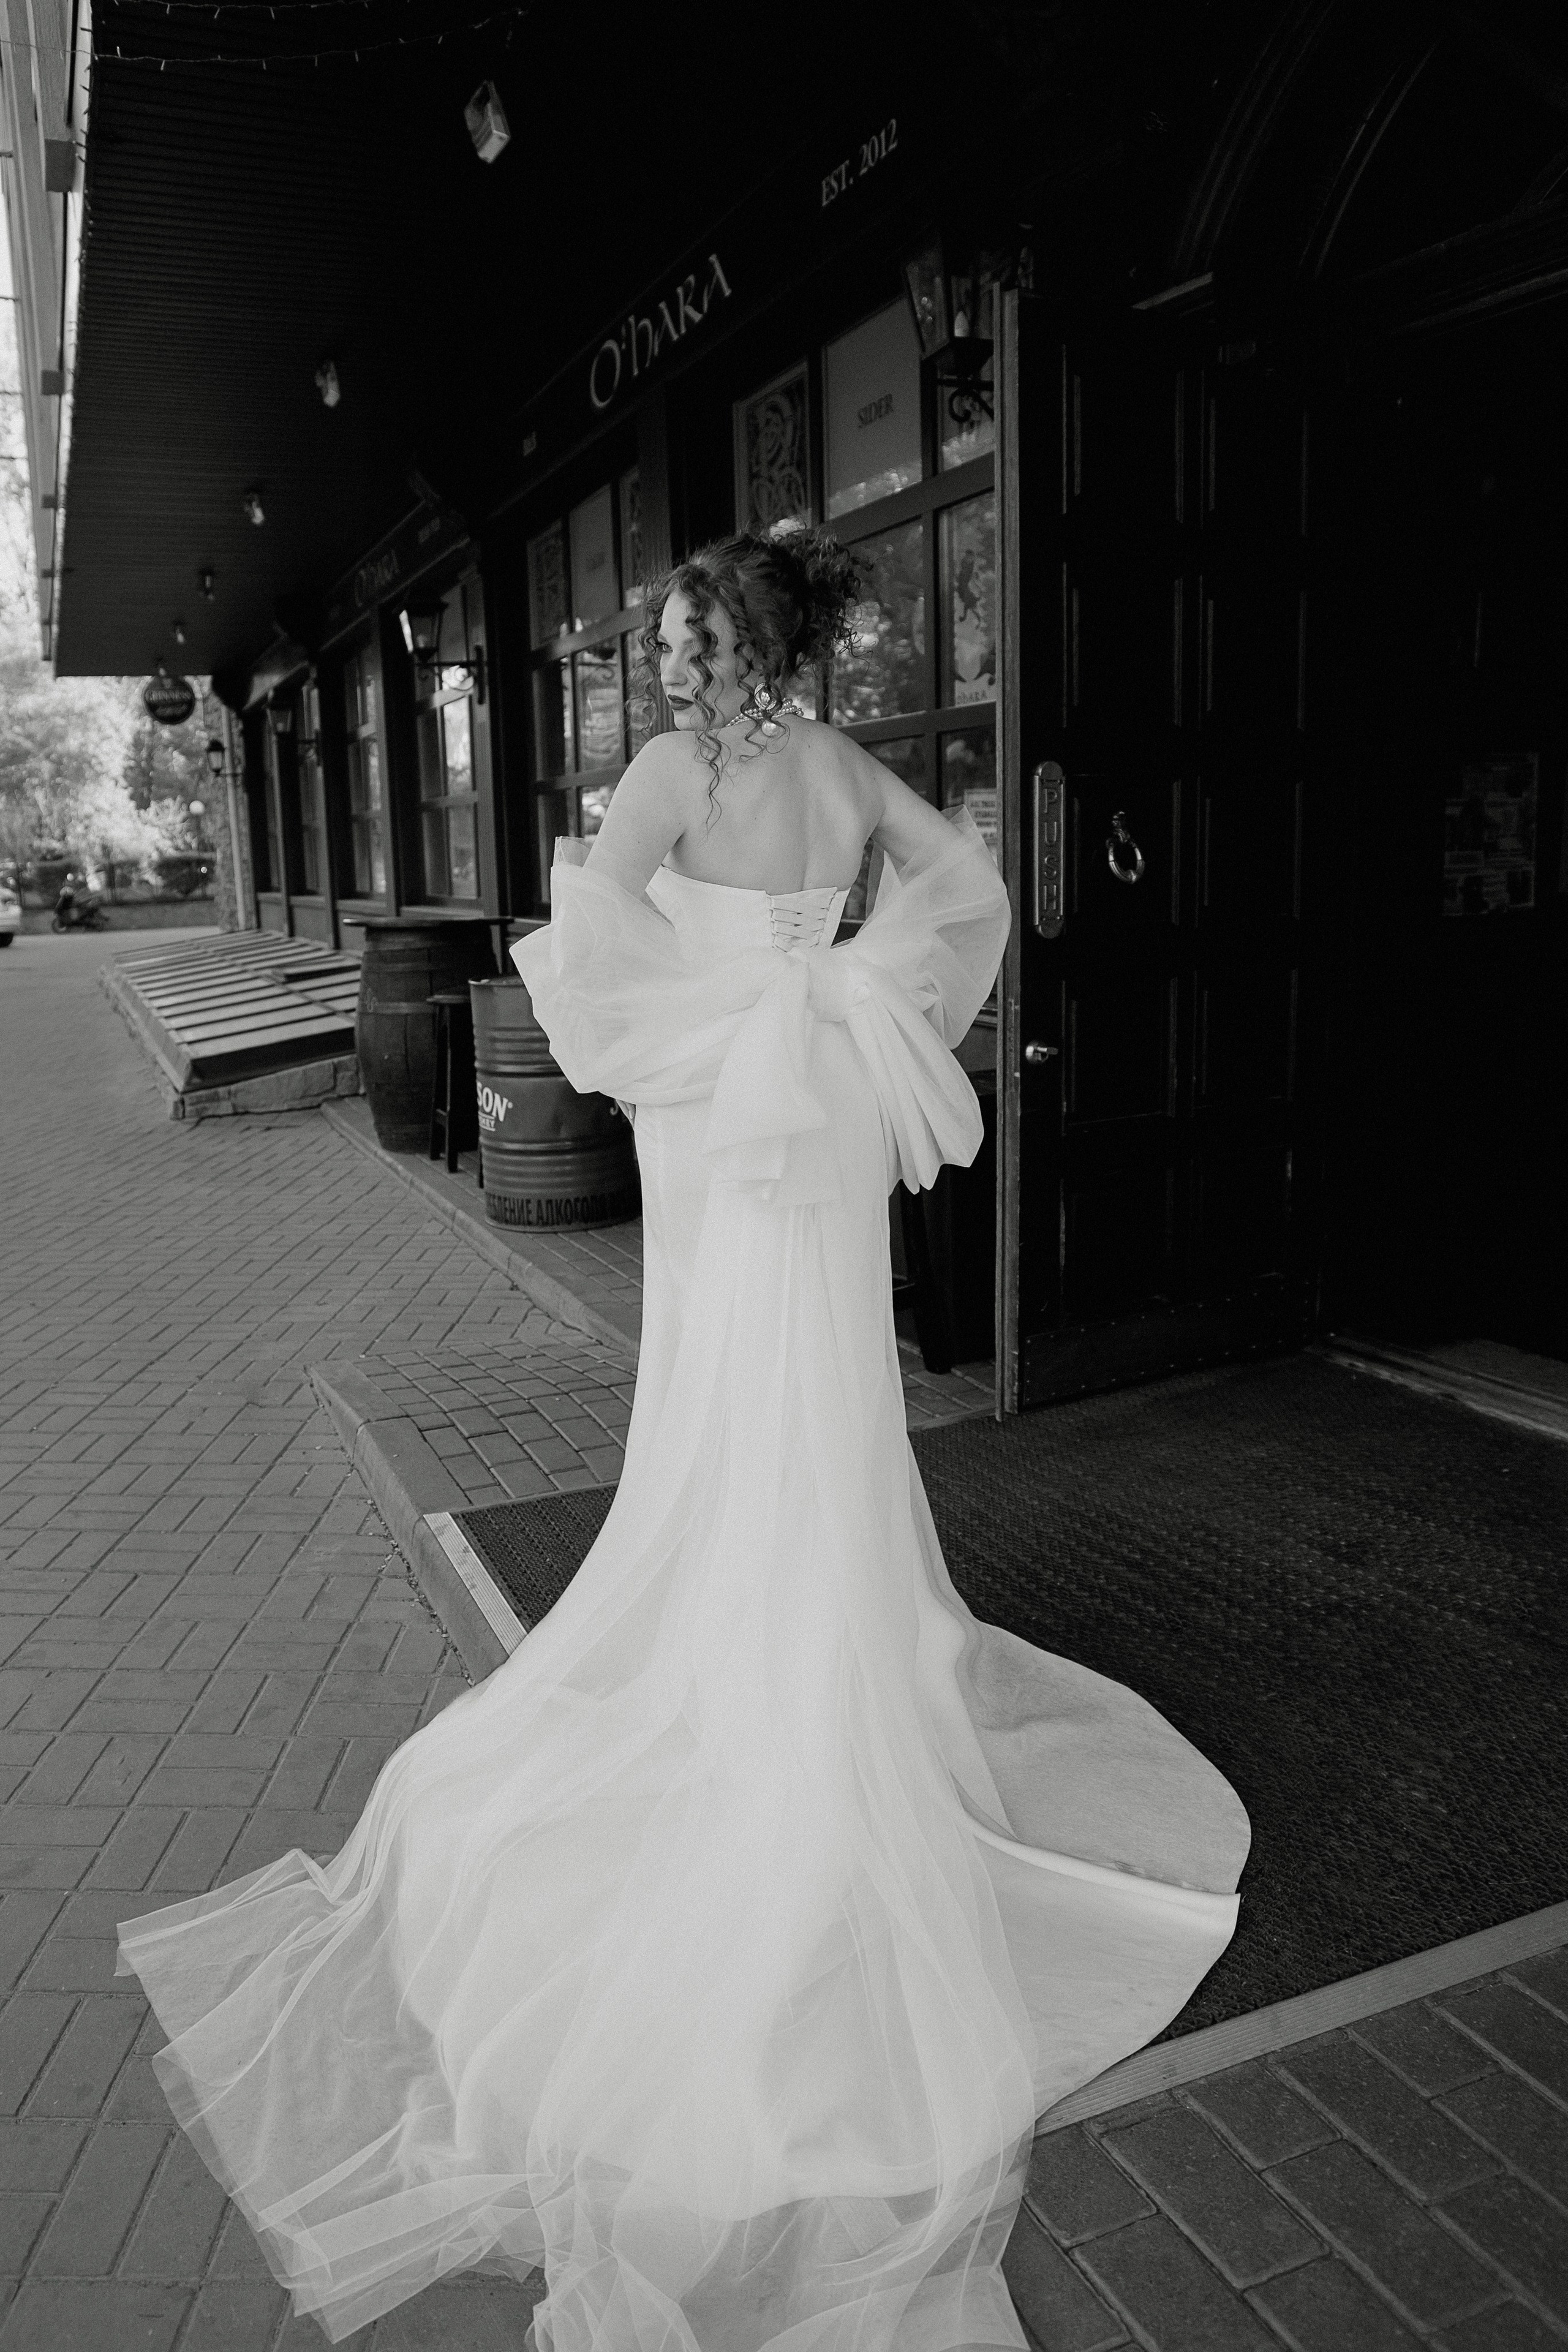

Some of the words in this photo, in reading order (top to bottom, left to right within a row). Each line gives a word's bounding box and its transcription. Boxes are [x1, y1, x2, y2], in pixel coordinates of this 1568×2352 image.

[822, 160, 854, 207] EST.
[859, 118, 899, 176] 2012
[1043, 788, 1058, 911] PUSH
